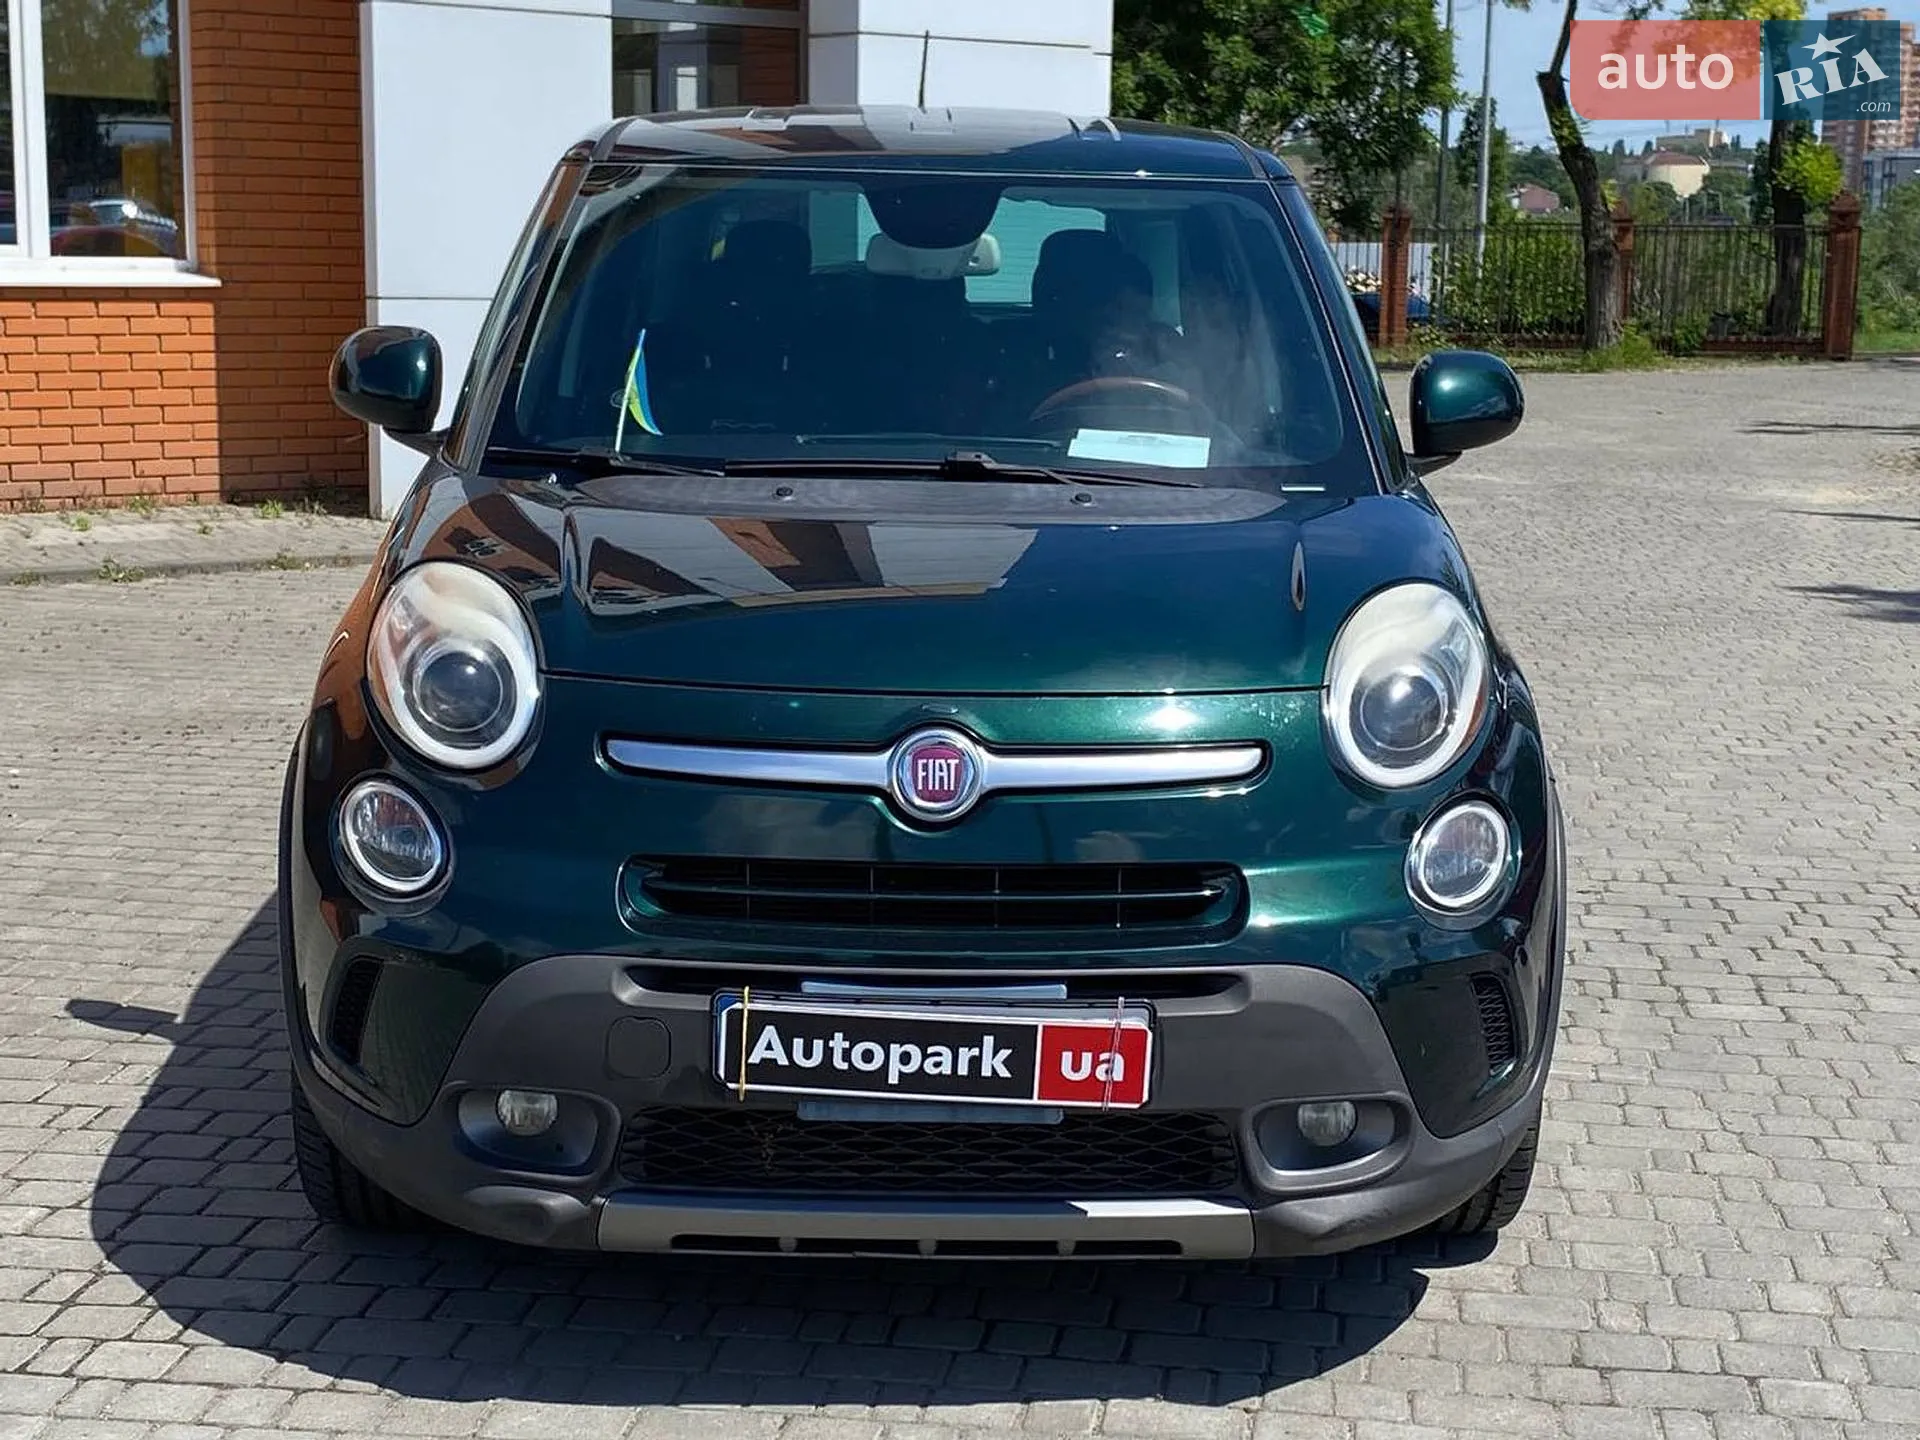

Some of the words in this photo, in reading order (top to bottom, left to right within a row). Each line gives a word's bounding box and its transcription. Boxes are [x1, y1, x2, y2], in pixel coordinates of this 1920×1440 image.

[917, 758, 960, 791] FIAT
[747, 1024, 1013, 1085] Autopark
[1060, 1050, 1126, 1082] ua
